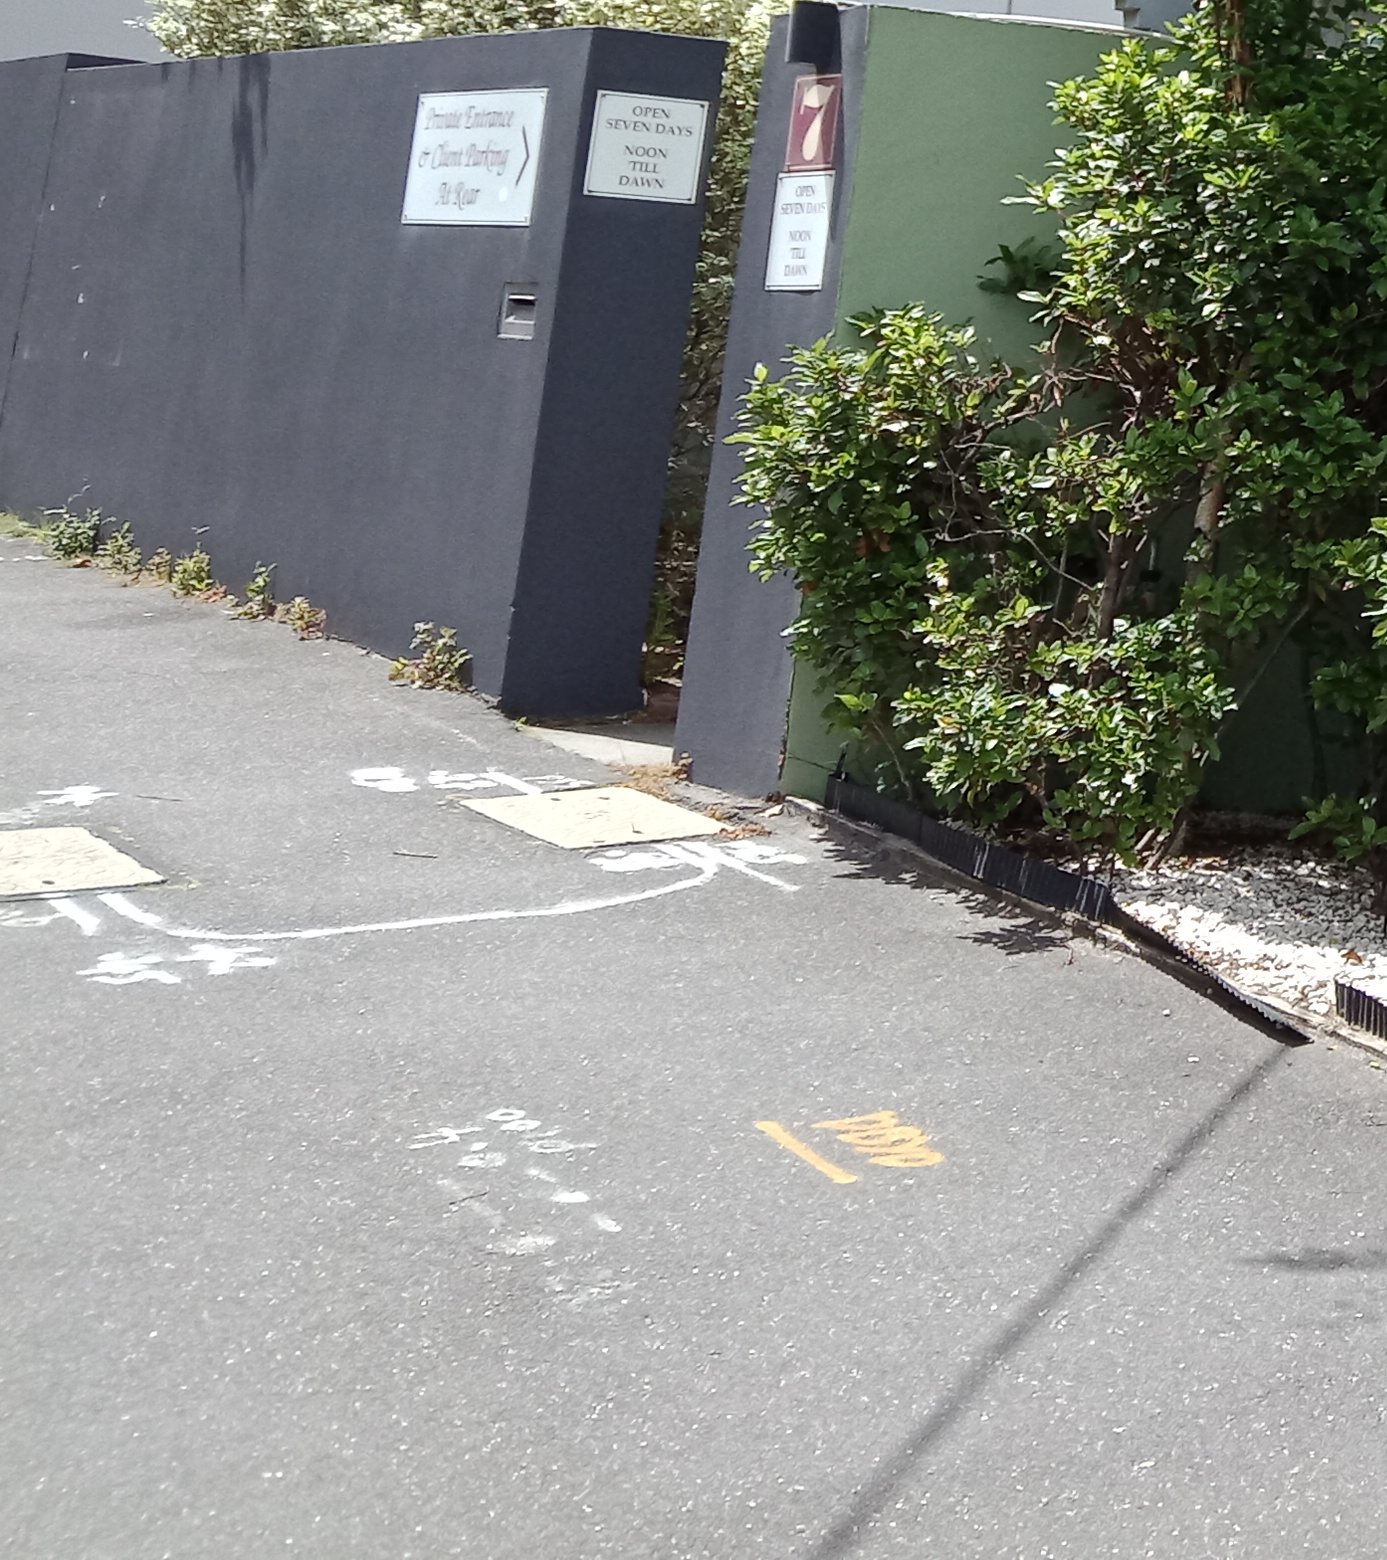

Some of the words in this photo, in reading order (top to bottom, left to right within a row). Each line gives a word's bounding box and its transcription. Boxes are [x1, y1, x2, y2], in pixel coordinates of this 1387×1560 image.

[424, 107, 463, 130] Private
[464, 105, 515, 130] Entrance
[632, 105, 671, 119] OPEN
[605, 119, 650, 133] SEVEN
[655, 123, 693, 137] DAYS
[800, 83, 836, 162] 7
[431, 140, 463, 170] Client
[464, 139, 510, 177] Parking
[624, 145, 668, 159] NOON
[619, 175, 665, 189] DAWN
[434, 181, 451, 206] At
[452, 181, 481, 211] Rear
[795, 185, 816, 198] OPEN
[780, 202, 805, 215] SEVEN
[806, 202, 827, 214] DAYS
[788, 230, 813, 242] NOON
[784, 265, 808, 277] DAWN
